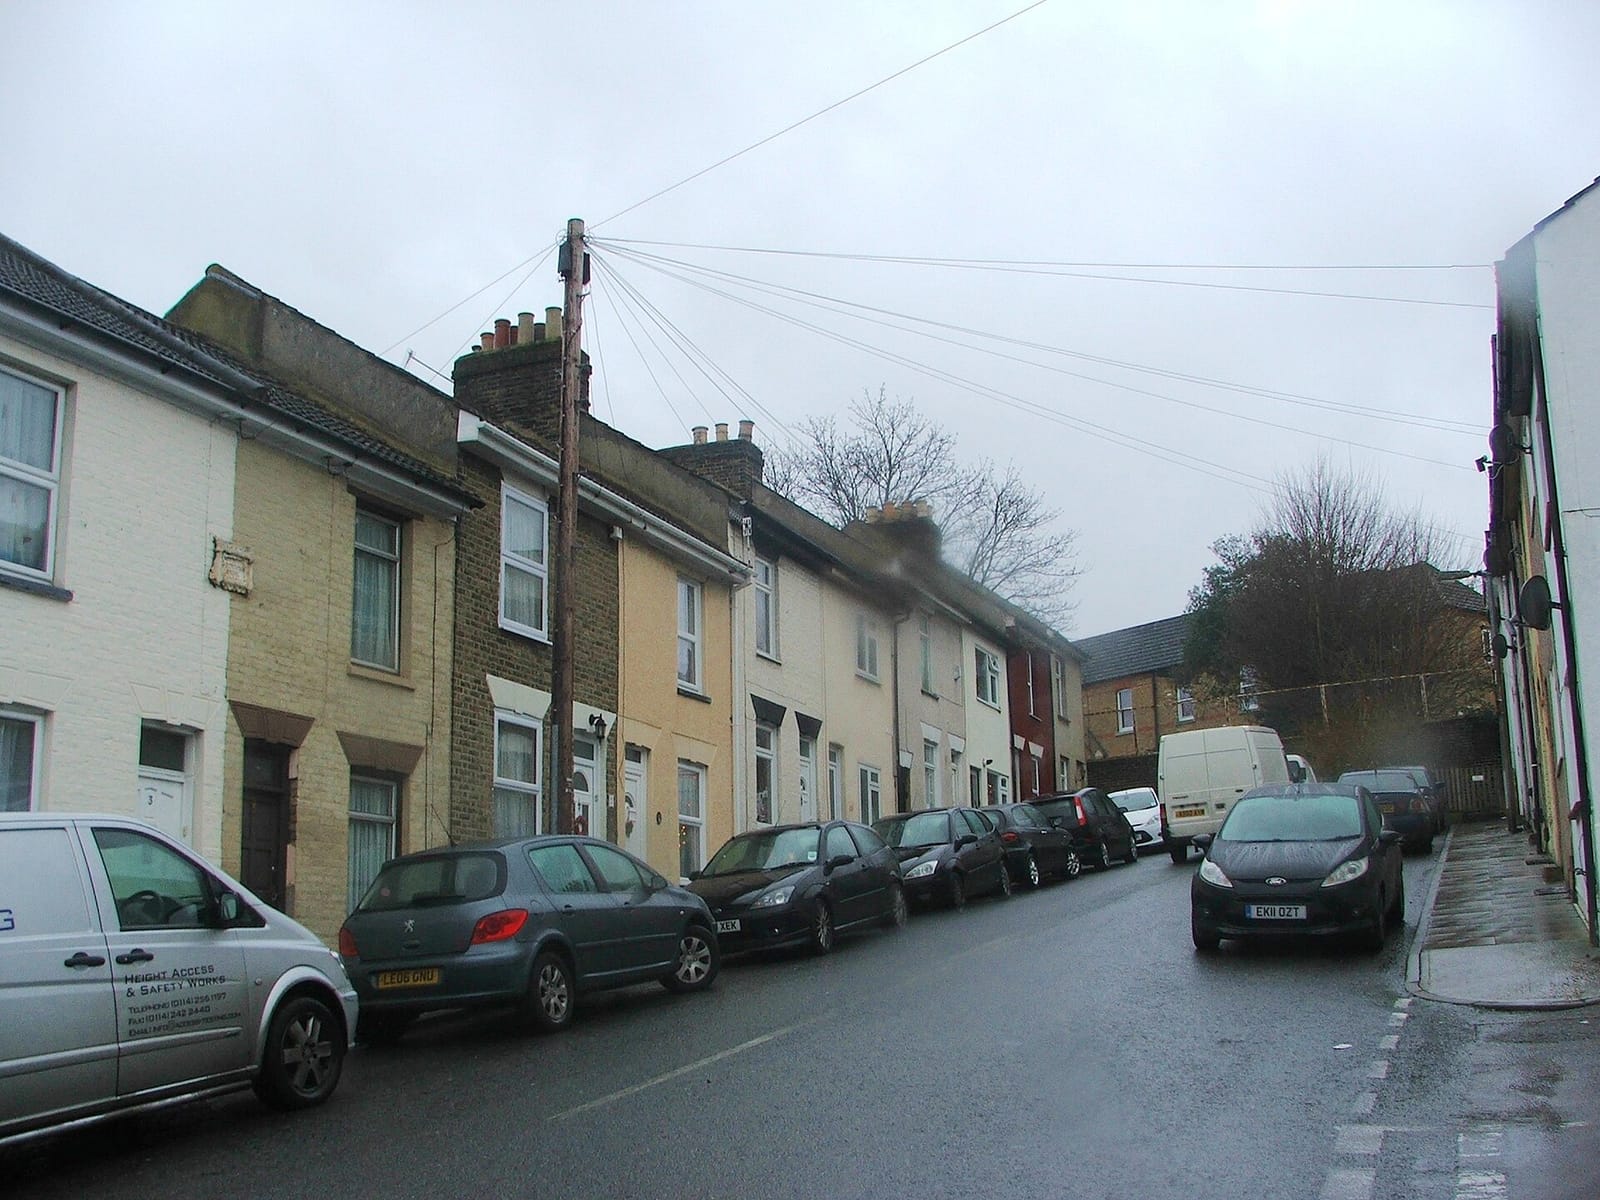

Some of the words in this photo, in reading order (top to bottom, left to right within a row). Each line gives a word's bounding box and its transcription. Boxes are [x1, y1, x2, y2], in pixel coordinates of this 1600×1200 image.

[1279, 906, 1299, 917] OZT
[125, 971, 168, 985] HEIGHT
[171, 965, 215, 979] ACCESS
[126, 987, 136, 998] &
[140, 981, 184, 996] SAFETY
[188, 975, 226, 989] WORKS
